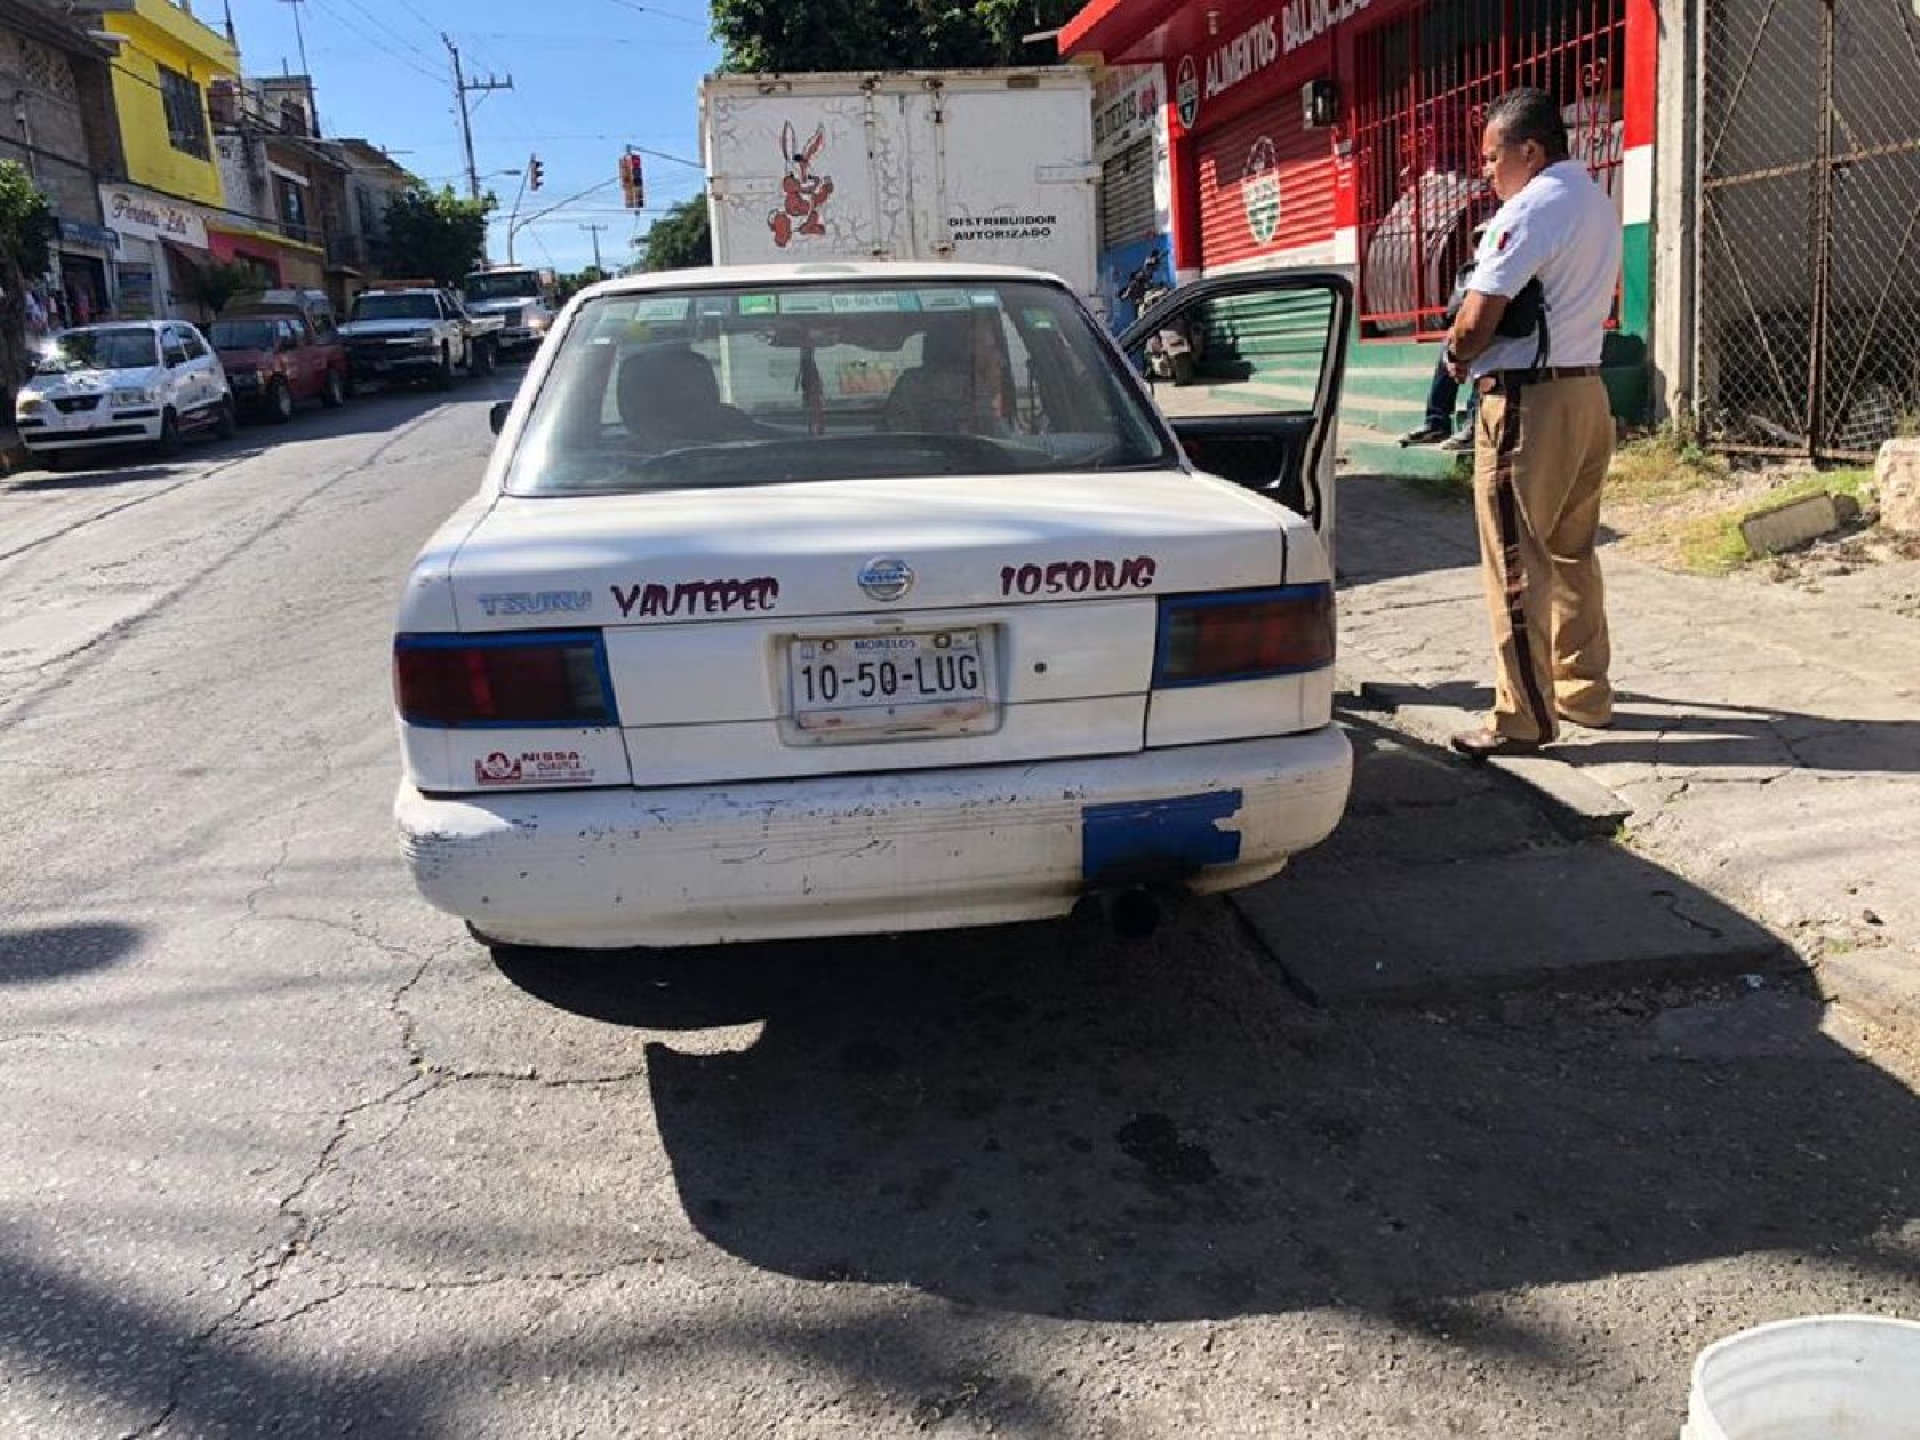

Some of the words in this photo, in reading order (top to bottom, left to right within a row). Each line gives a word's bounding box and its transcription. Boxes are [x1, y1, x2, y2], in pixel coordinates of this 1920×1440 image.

[1204, 15, 1276, 99] ALIMENTOS
[948, 215, 1057, 227] DISTRIBUIDOR
[953, 227, 1051, 240] AUTORIZADO
[478, 590, 593, 616] TSURU
[610, 576, 780, 618] YAUTEPEC
[854, 638, 916, 650] MORELOS
[802, 654, 978, 703] 10-50-LUG
